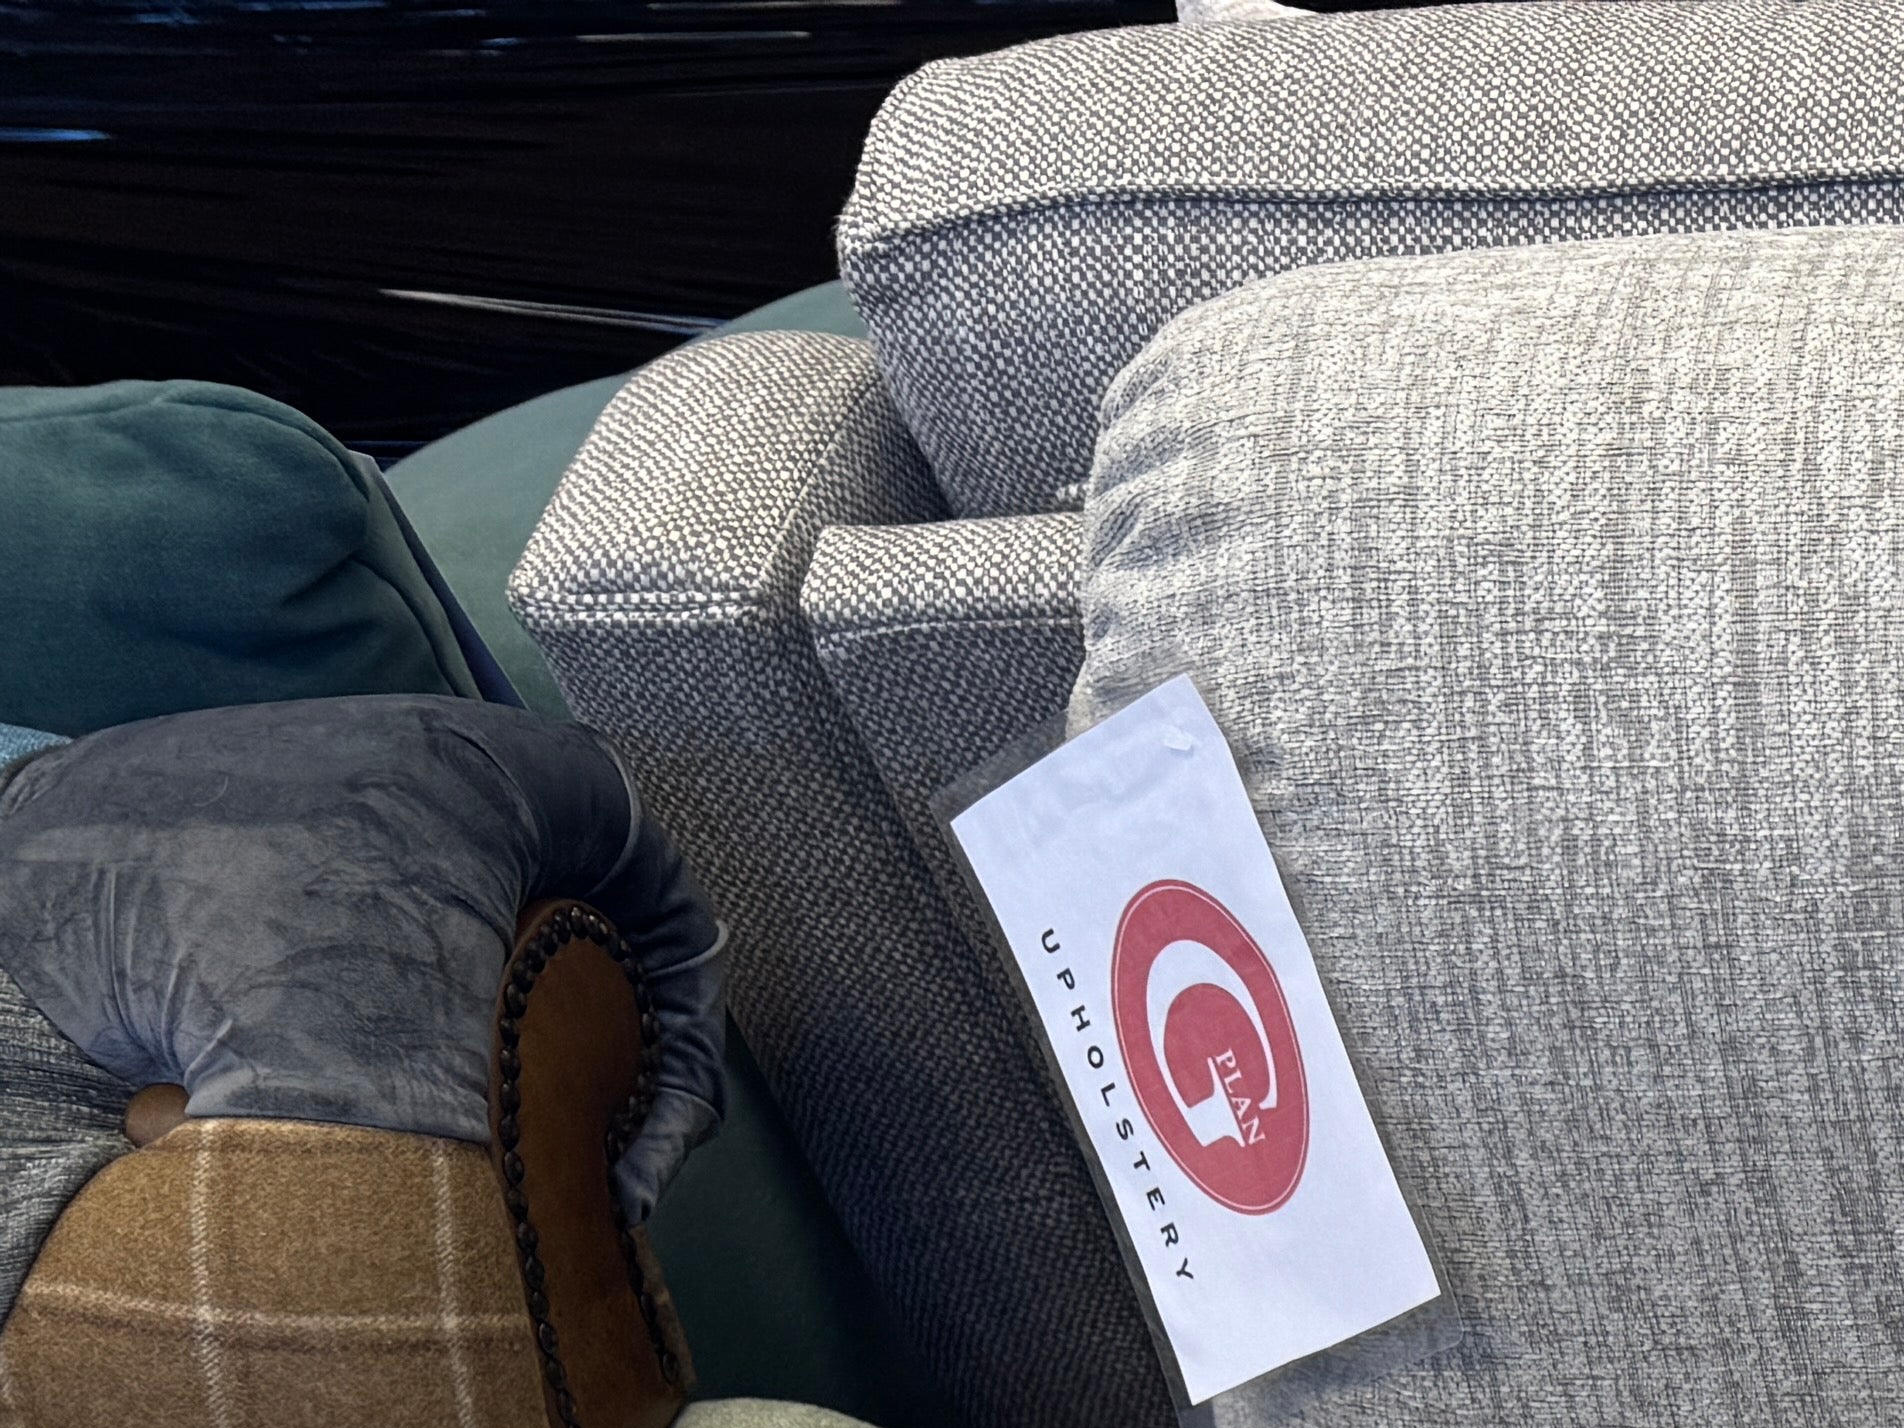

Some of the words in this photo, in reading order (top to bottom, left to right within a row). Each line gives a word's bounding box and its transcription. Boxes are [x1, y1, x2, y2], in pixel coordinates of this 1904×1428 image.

[1040, 927, 1195, 1280] UPHOLSTERY
[1146, 939, 1277, 1147] G
[1214, 1047, 1266, 1146] PLAN
